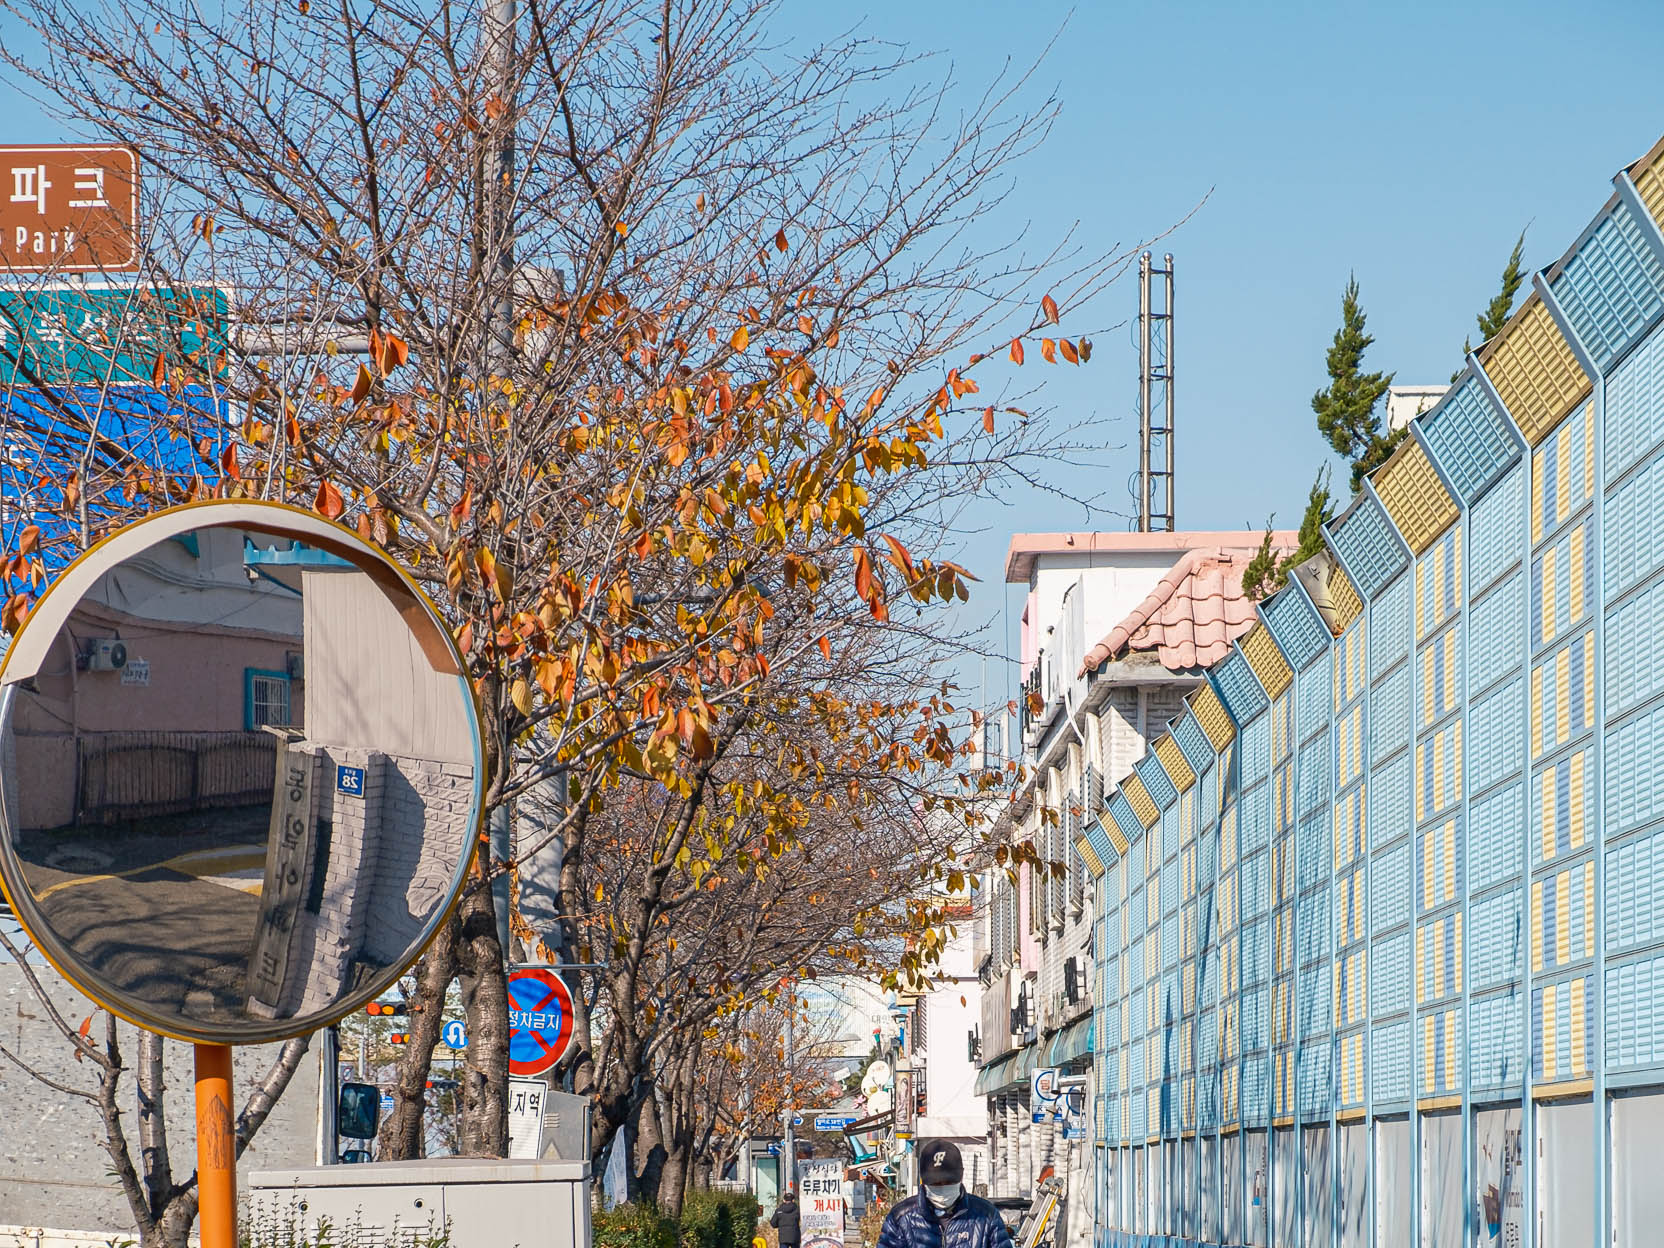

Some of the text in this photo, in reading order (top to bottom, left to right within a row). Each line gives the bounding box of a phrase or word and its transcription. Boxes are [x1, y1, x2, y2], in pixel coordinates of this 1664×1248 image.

[10, 165, 110, 214] 파크
[16, 226, 76, 254] Park
[508, 1090, 540, 1117] 지역
[803, 1179, 840, 1195] 두루치기
[813, 1199, 841, 1212] 개시!
